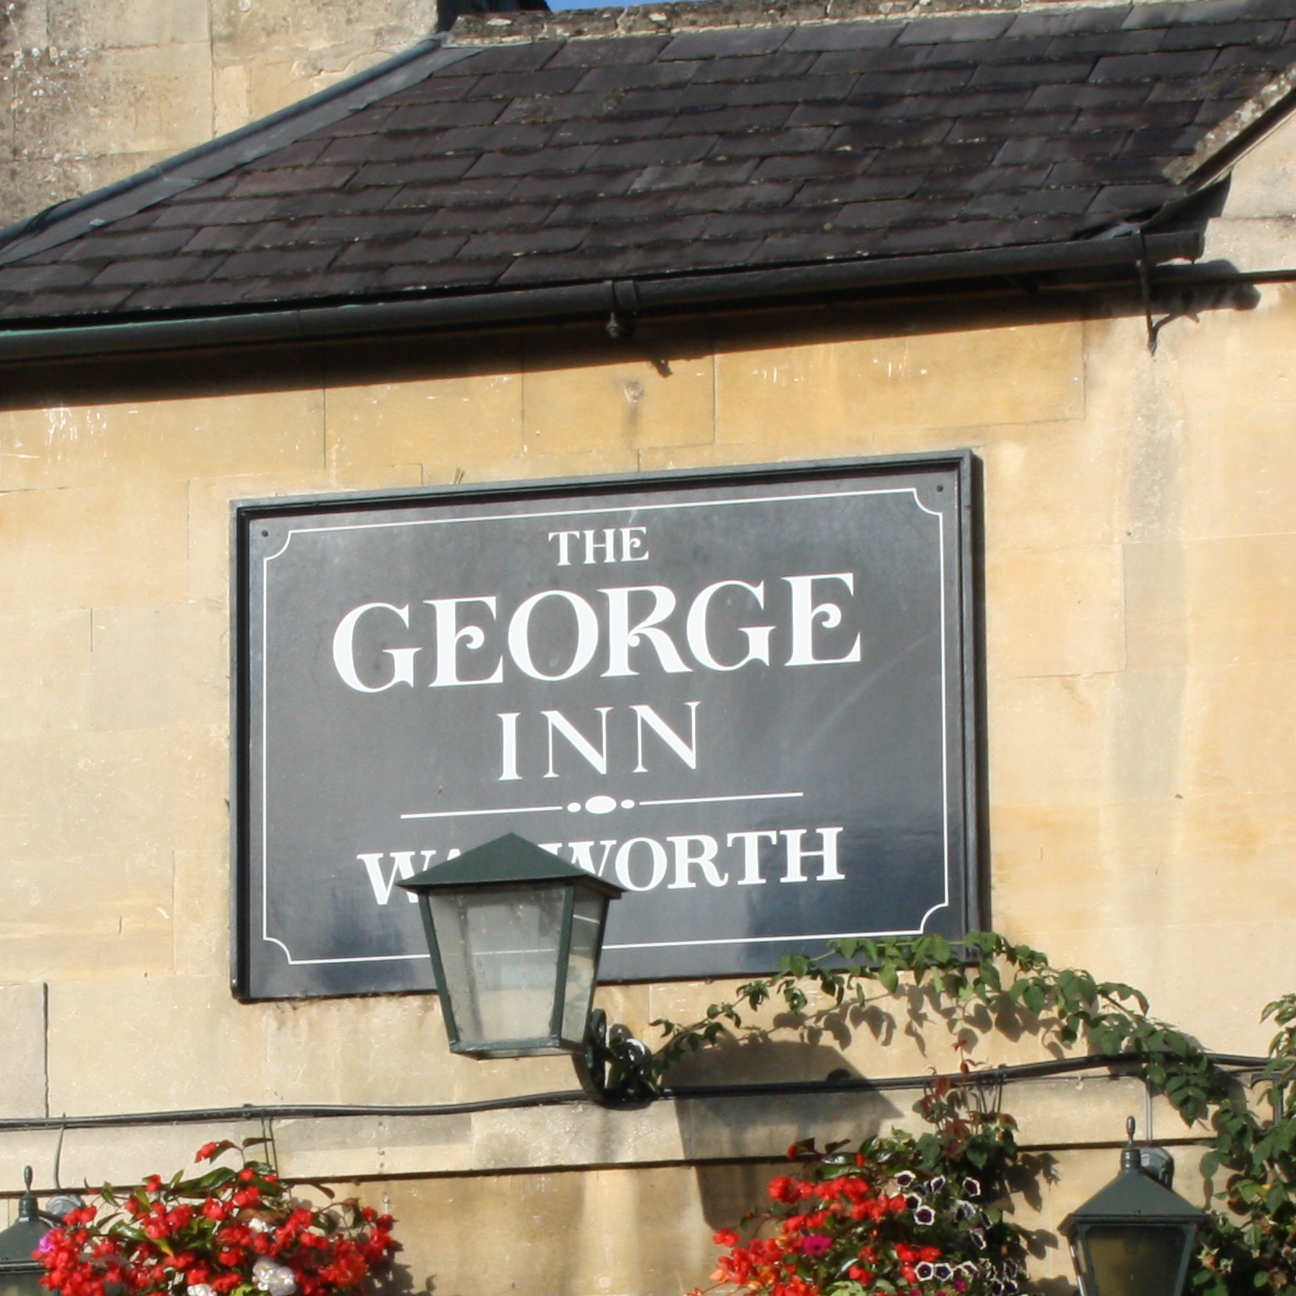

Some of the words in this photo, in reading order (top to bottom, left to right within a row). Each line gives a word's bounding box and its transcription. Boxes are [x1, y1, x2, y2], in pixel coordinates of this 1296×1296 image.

[548, 525, 649, 567] THE
[331, 571, 863, 694] GEORGE
[496, 700, 702, 781] INN
[356, 826, 846, 906] WWORTH
